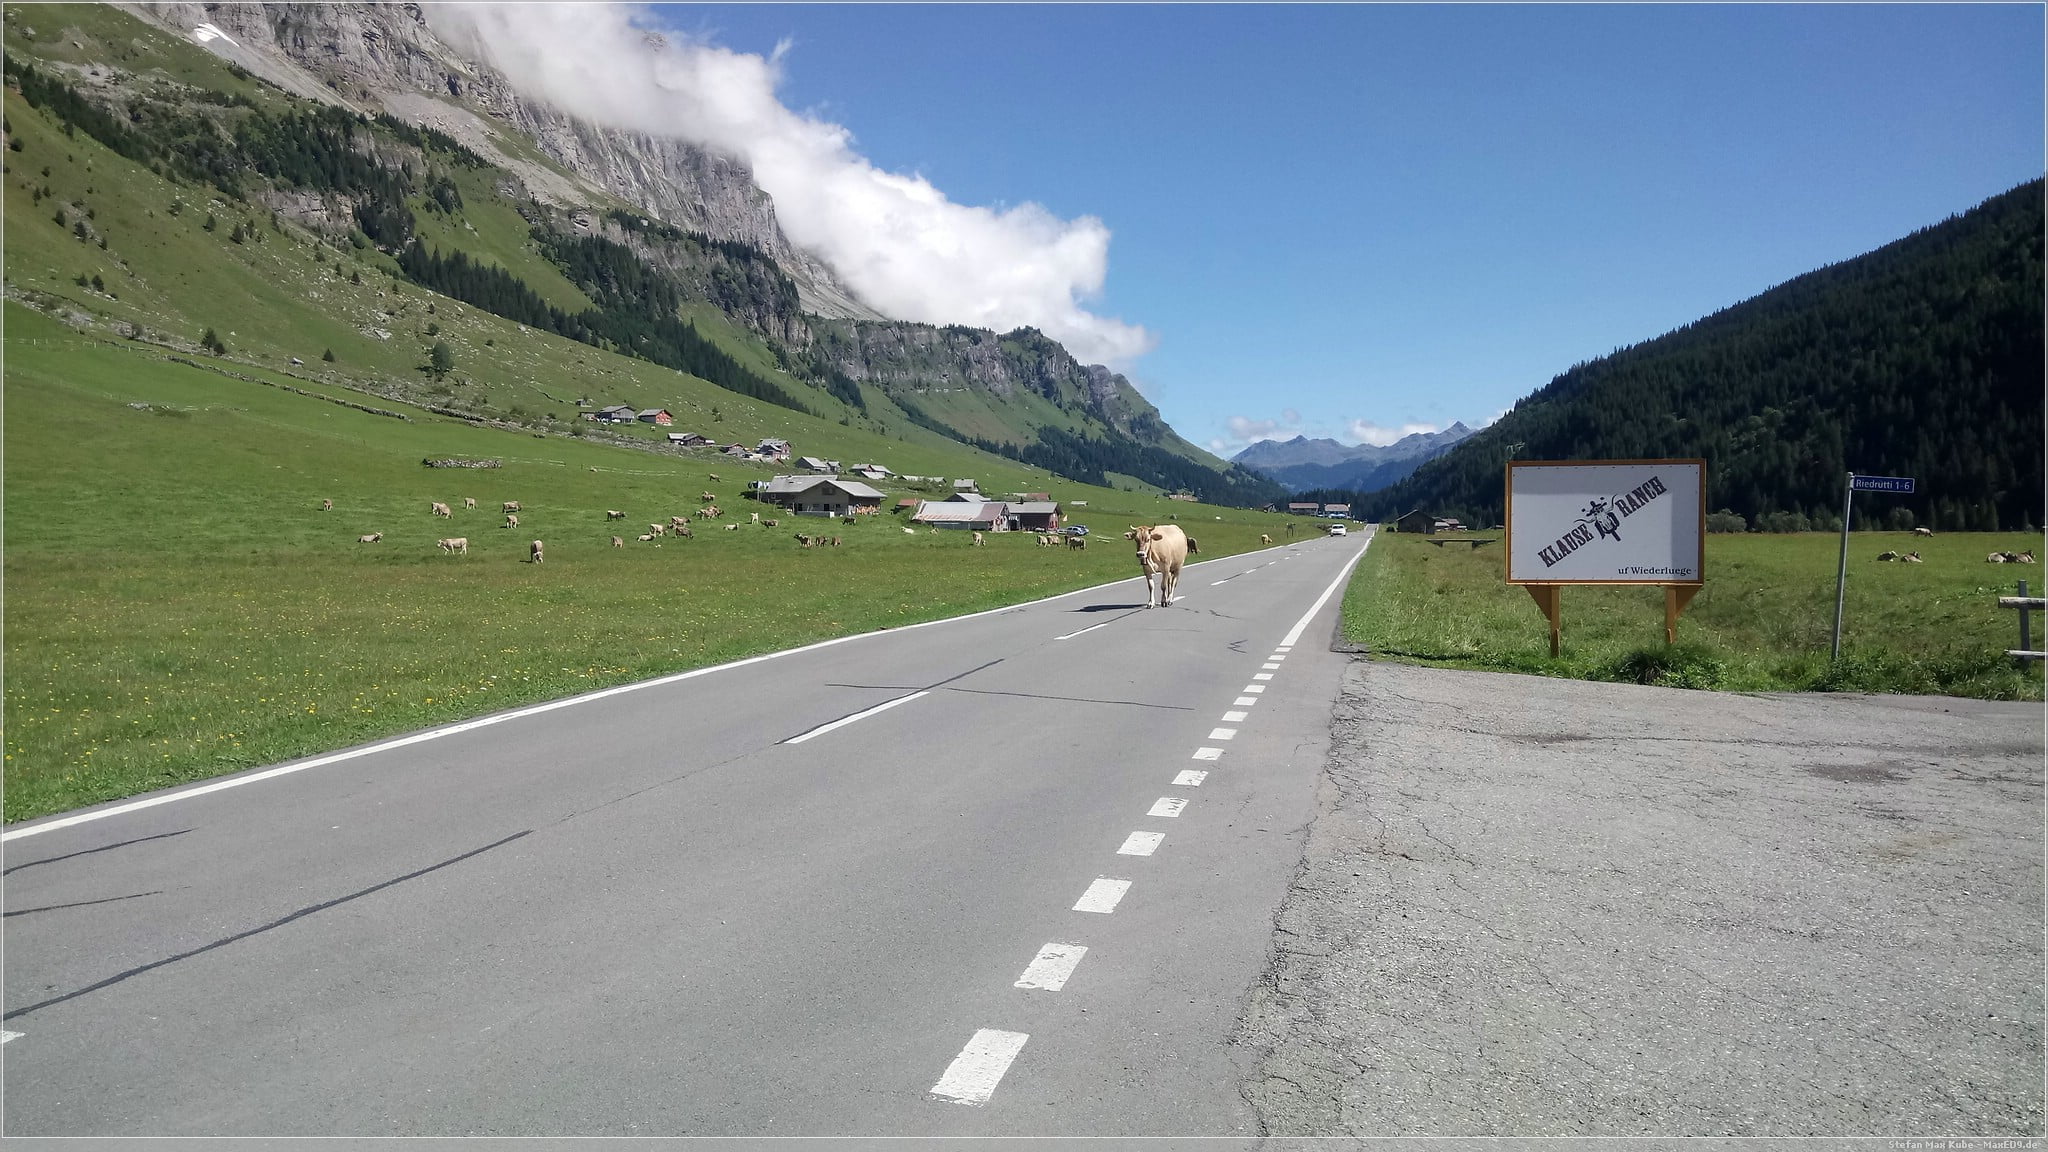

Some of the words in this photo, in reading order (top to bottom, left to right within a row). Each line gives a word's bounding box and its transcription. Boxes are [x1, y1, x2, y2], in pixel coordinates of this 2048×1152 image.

[1537, 523, 1594, 568] KLAUSE
[1614, 476, 1667, 518] RANCH
[1618, 566, 1629, 575] uf
[1631, 566, 1692, 576] Wiederluege
